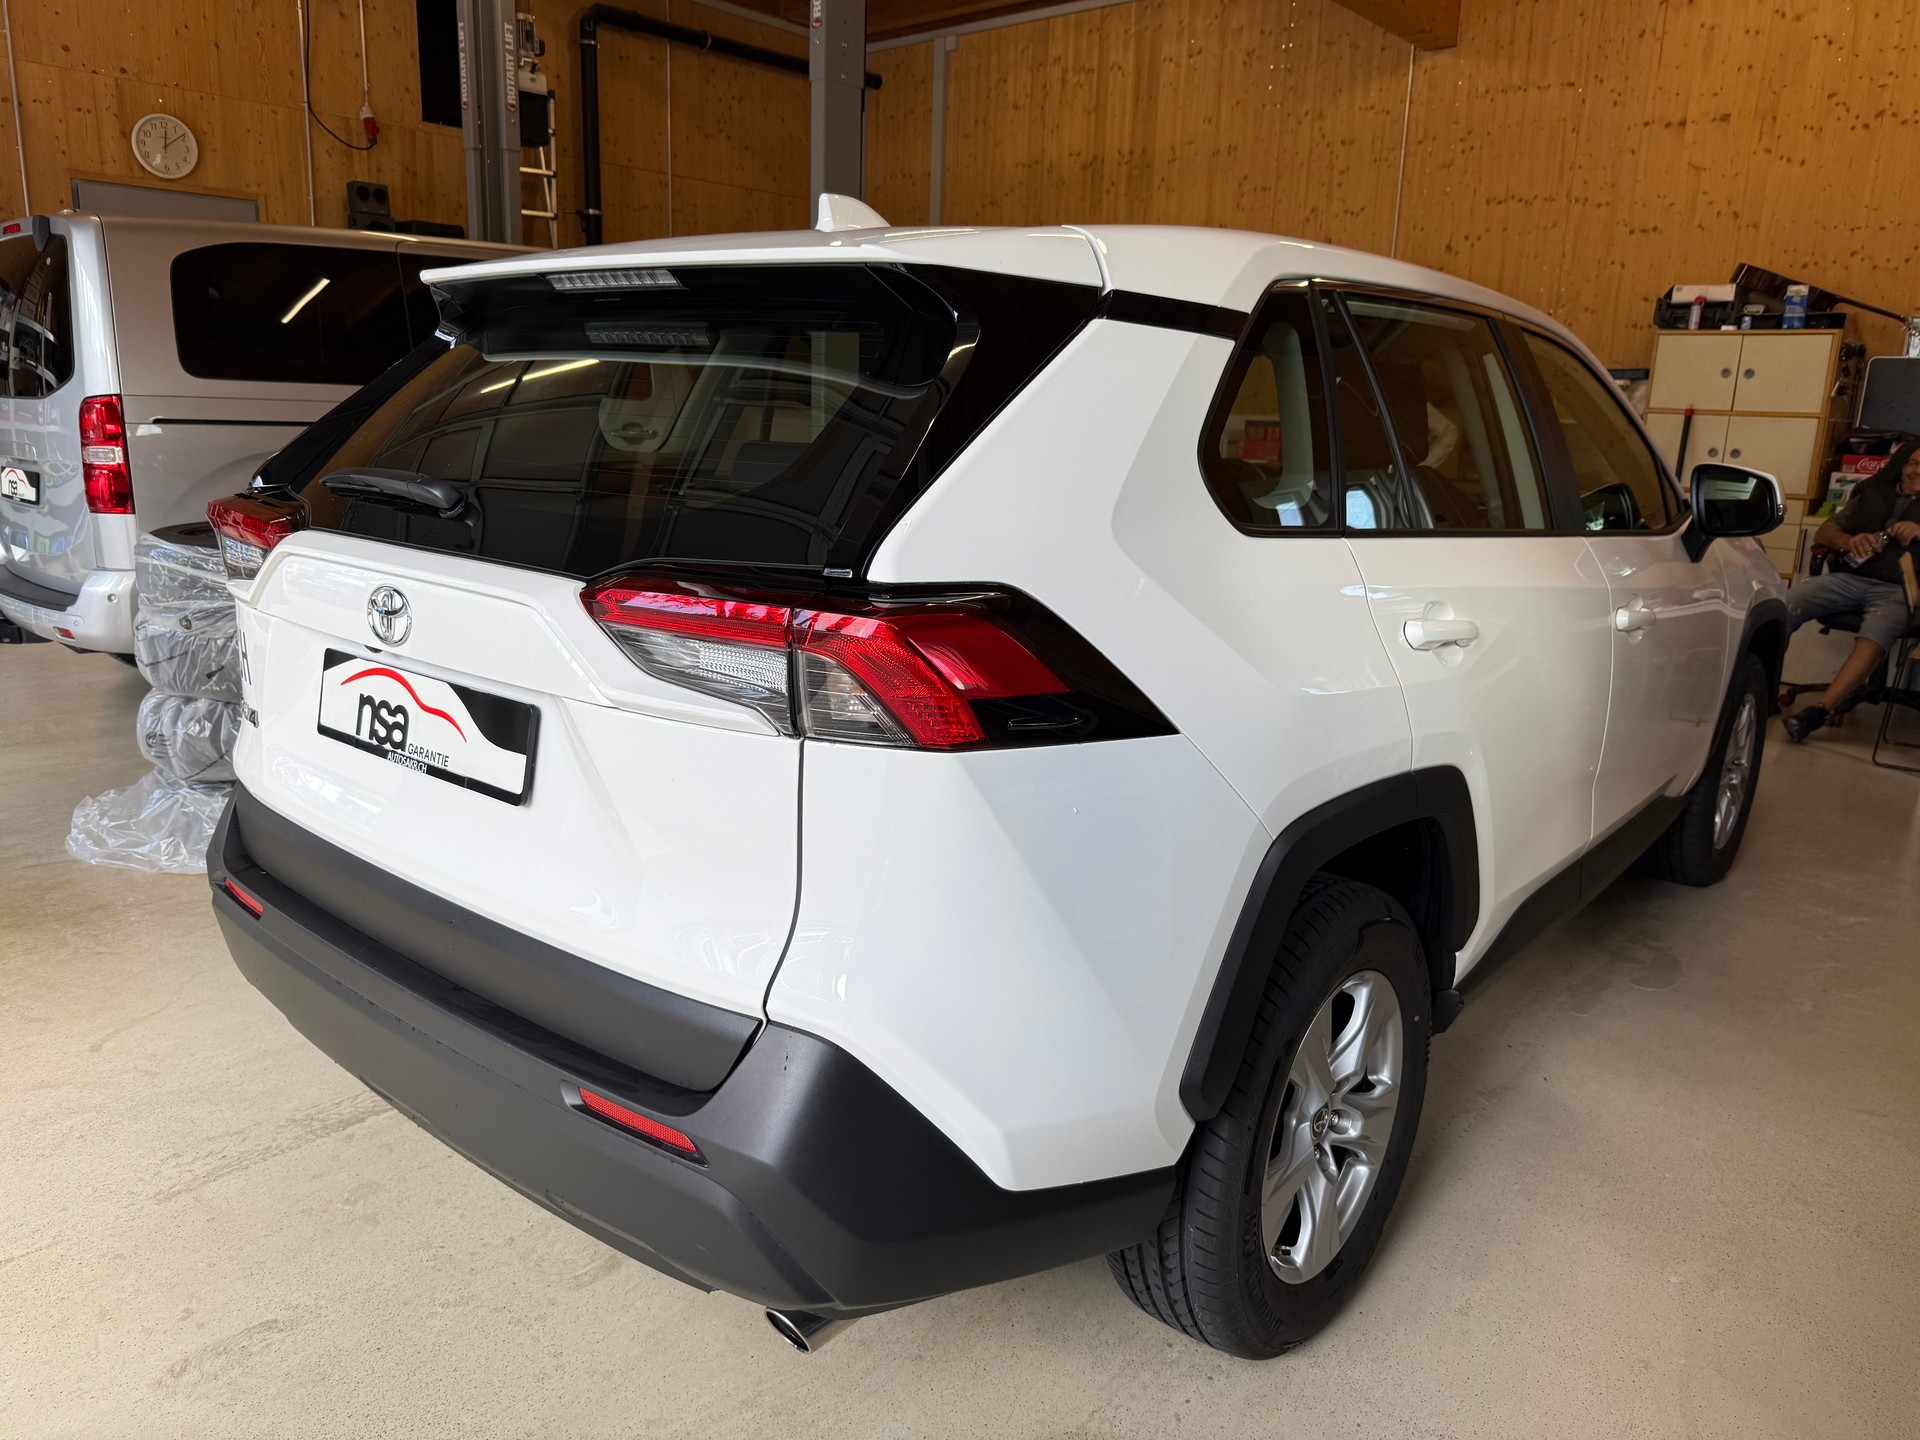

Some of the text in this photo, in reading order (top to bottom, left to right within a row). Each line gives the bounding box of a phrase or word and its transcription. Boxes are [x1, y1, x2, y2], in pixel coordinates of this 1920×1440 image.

[459, 52, 468, 101] ROTARY
[504, 22, 516, 105] ROTARY LIFT
[356, 693, 410, 752] nsa
[408, 743, 449, 767] GARANTIE
